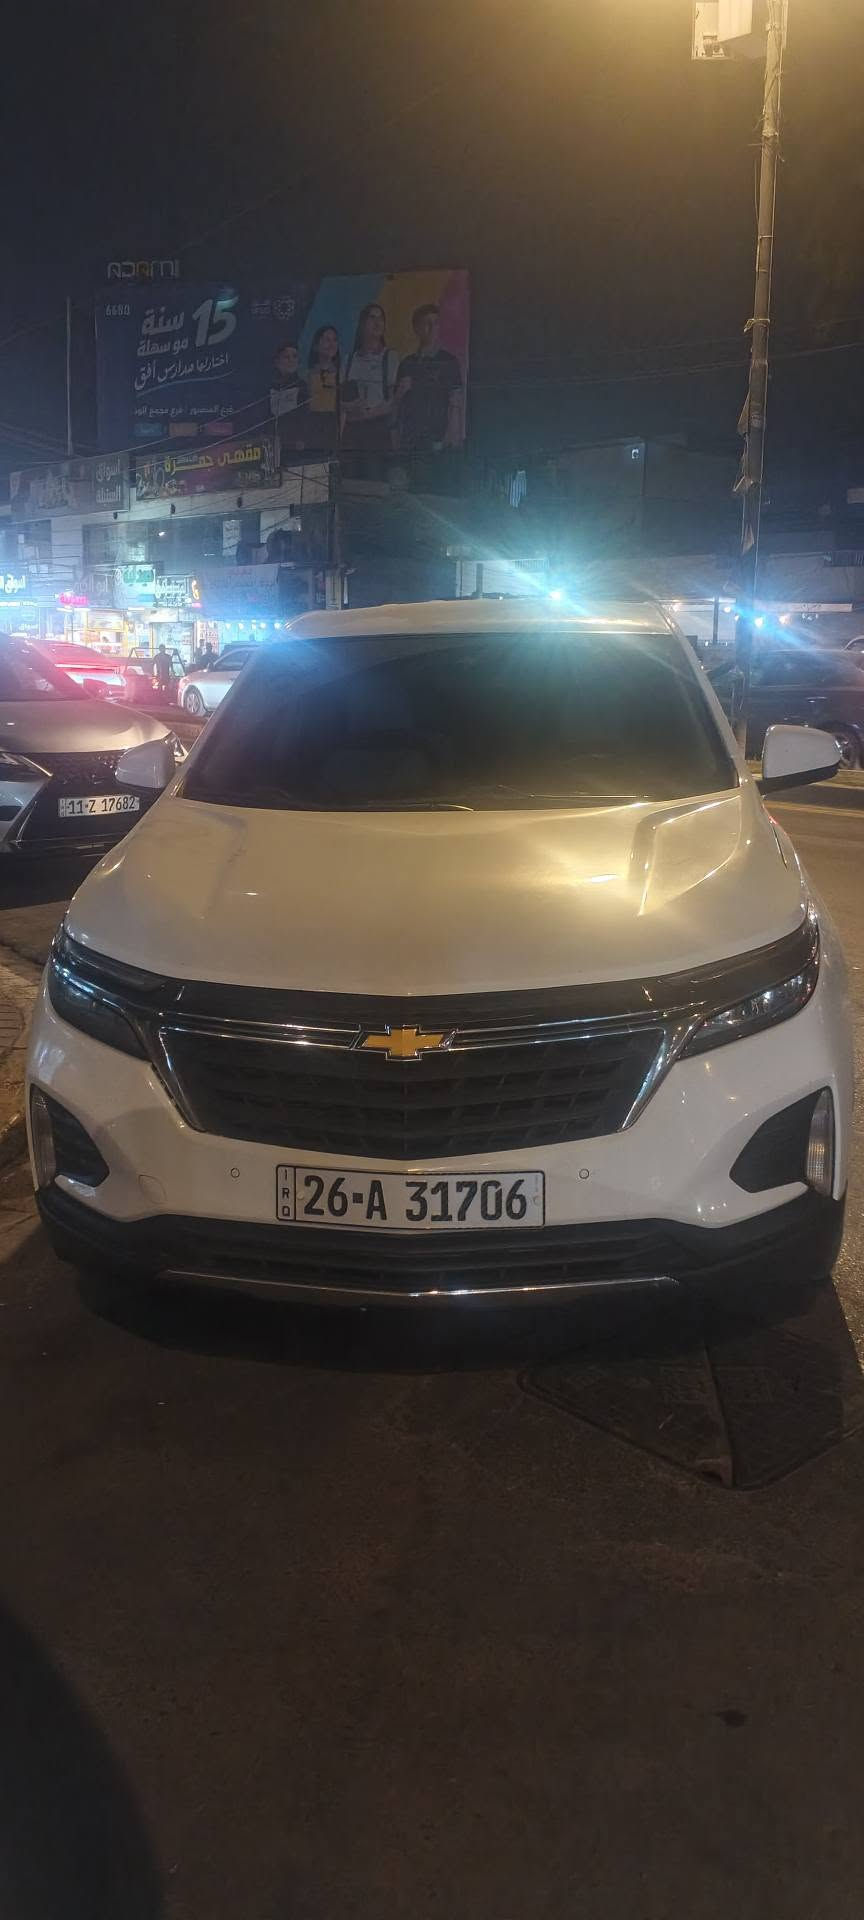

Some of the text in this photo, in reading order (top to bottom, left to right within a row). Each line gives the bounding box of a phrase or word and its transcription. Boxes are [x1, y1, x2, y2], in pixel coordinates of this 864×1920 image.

[141, 306, 185, 336] سنة
[192, 295, 239, 347] 15
[137, 337, 171, 357] سهلة
[157, 359, 194, 383] مدارس
[101, 796, 136, 812] 17682
[303, 1174, 528, 1223] 26-A 31706
